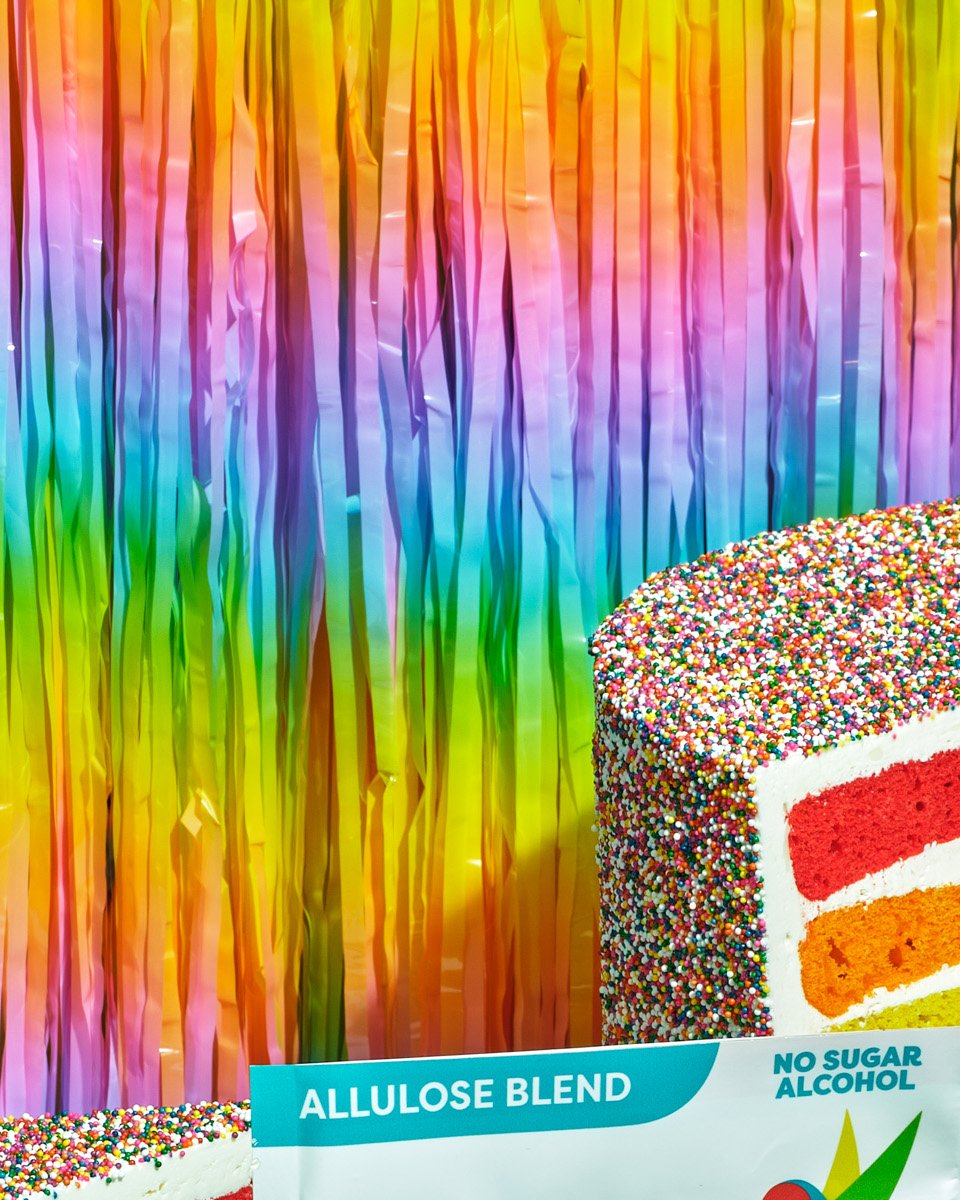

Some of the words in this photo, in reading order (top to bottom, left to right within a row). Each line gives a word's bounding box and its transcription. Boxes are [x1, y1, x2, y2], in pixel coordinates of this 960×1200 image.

[773, 1051, 816, 1075] NO
[823, 1045, 922, 1072] SUGAR
[299, 1075, 495, 1121] ALLULOSE
[506, 1071, 632, 1107] BLEND
[775, 1068, 916, 1100] ALCOHOL
